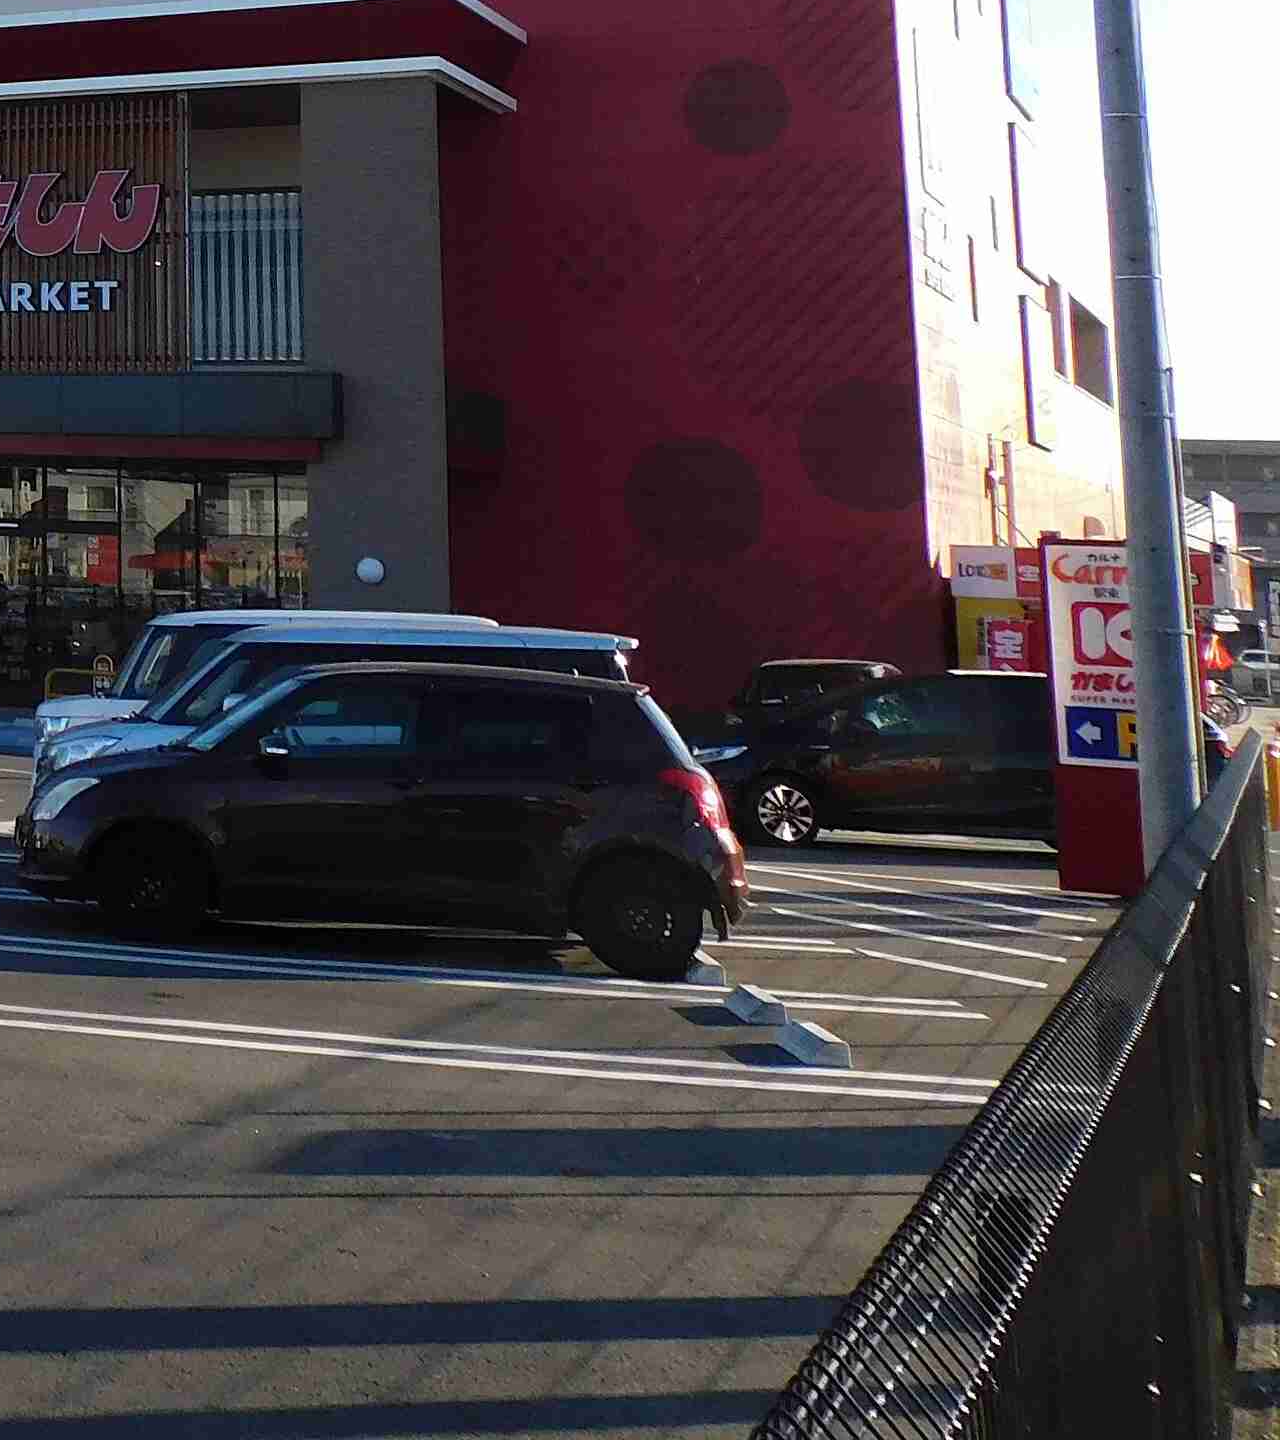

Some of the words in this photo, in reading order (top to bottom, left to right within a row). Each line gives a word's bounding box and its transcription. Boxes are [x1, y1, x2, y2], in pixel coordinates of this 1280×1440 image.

[1053, 553, 1128, 584] Carn
[1070, 672, 1136, 693] かまし
